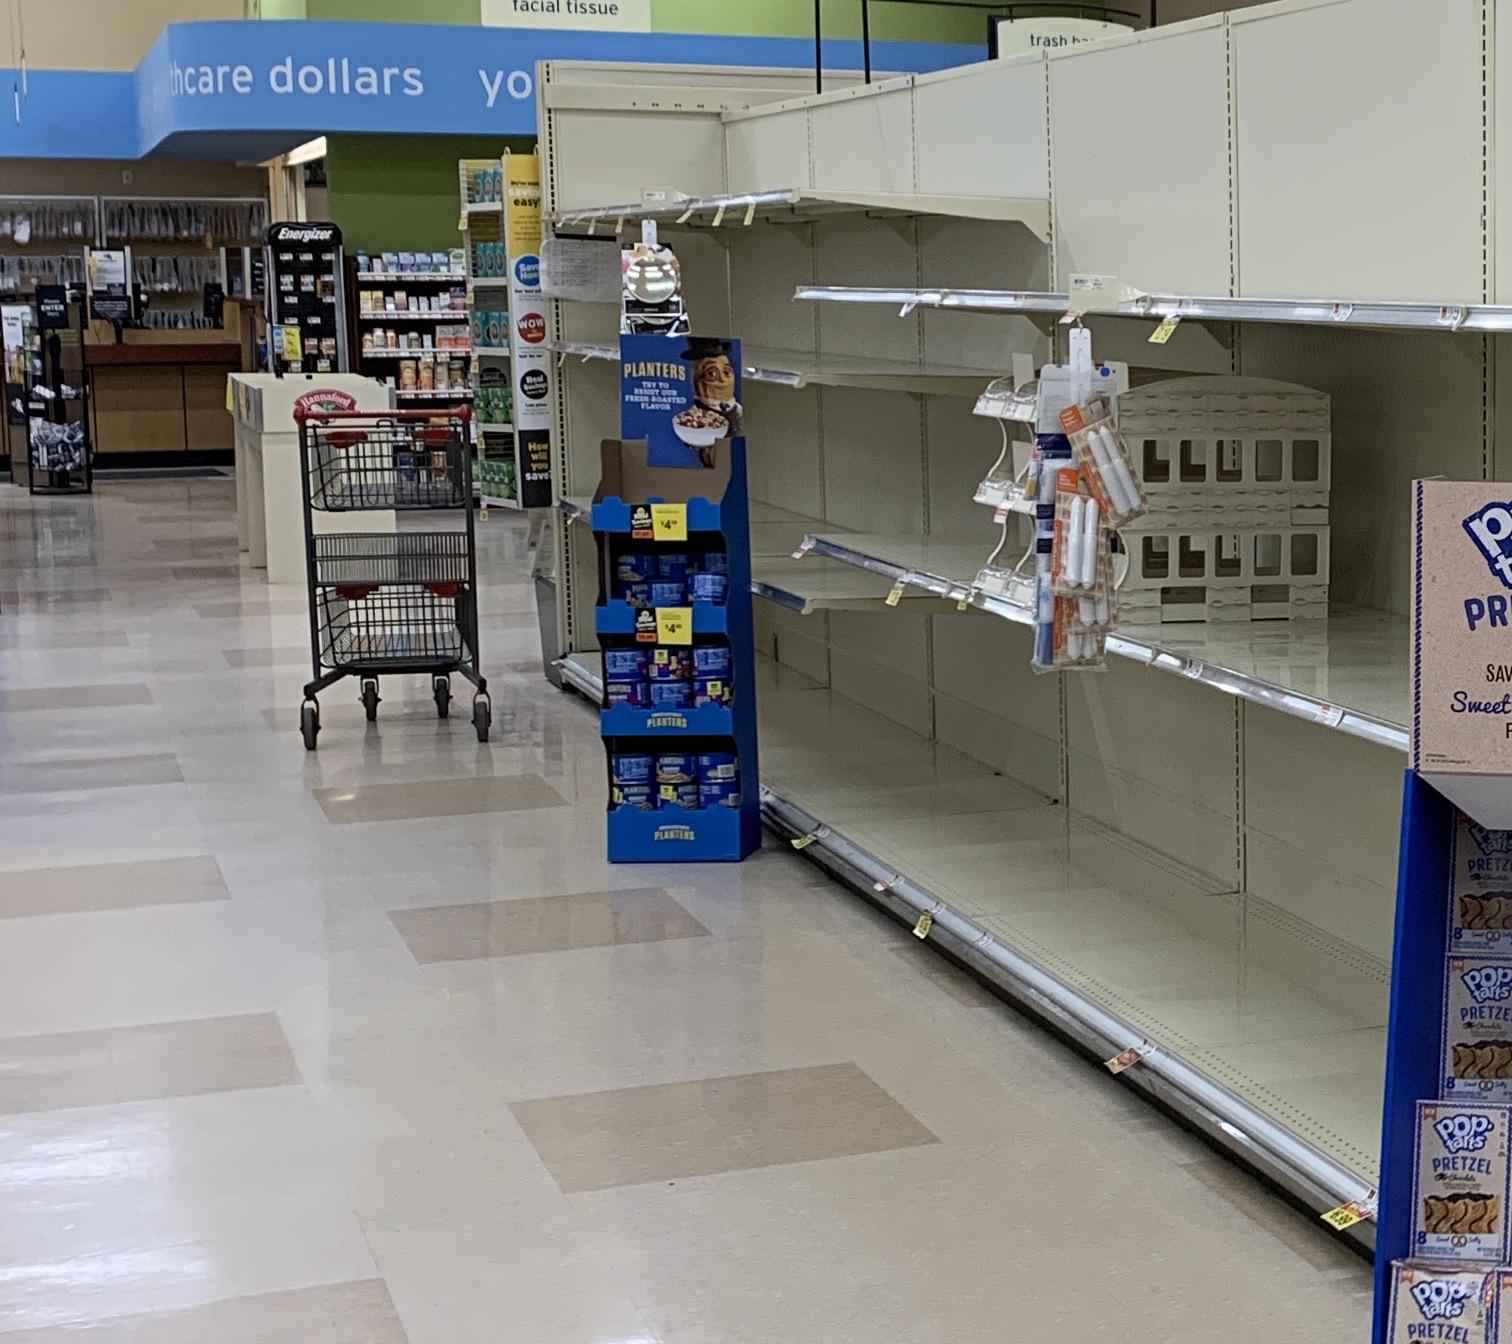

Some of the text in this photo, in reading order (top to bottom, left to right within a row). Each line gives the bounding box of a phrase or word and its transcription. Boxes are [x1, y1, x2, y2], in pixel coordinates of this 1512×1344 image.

[1031, 33, 1067, 47] trash
[269, 55, 424, 97] dollars
[278, 227, 333, 242] Energizer
[624, 362, 685, 381] PLANTERS
[1450, 690, 1512, 714] Sweet
[1432, 1156, 1492, 1175] PRETZEL
[1417, 1231, 1427, 1244] 8
[1408, 1323, 1469, 1344] PRETZEL
